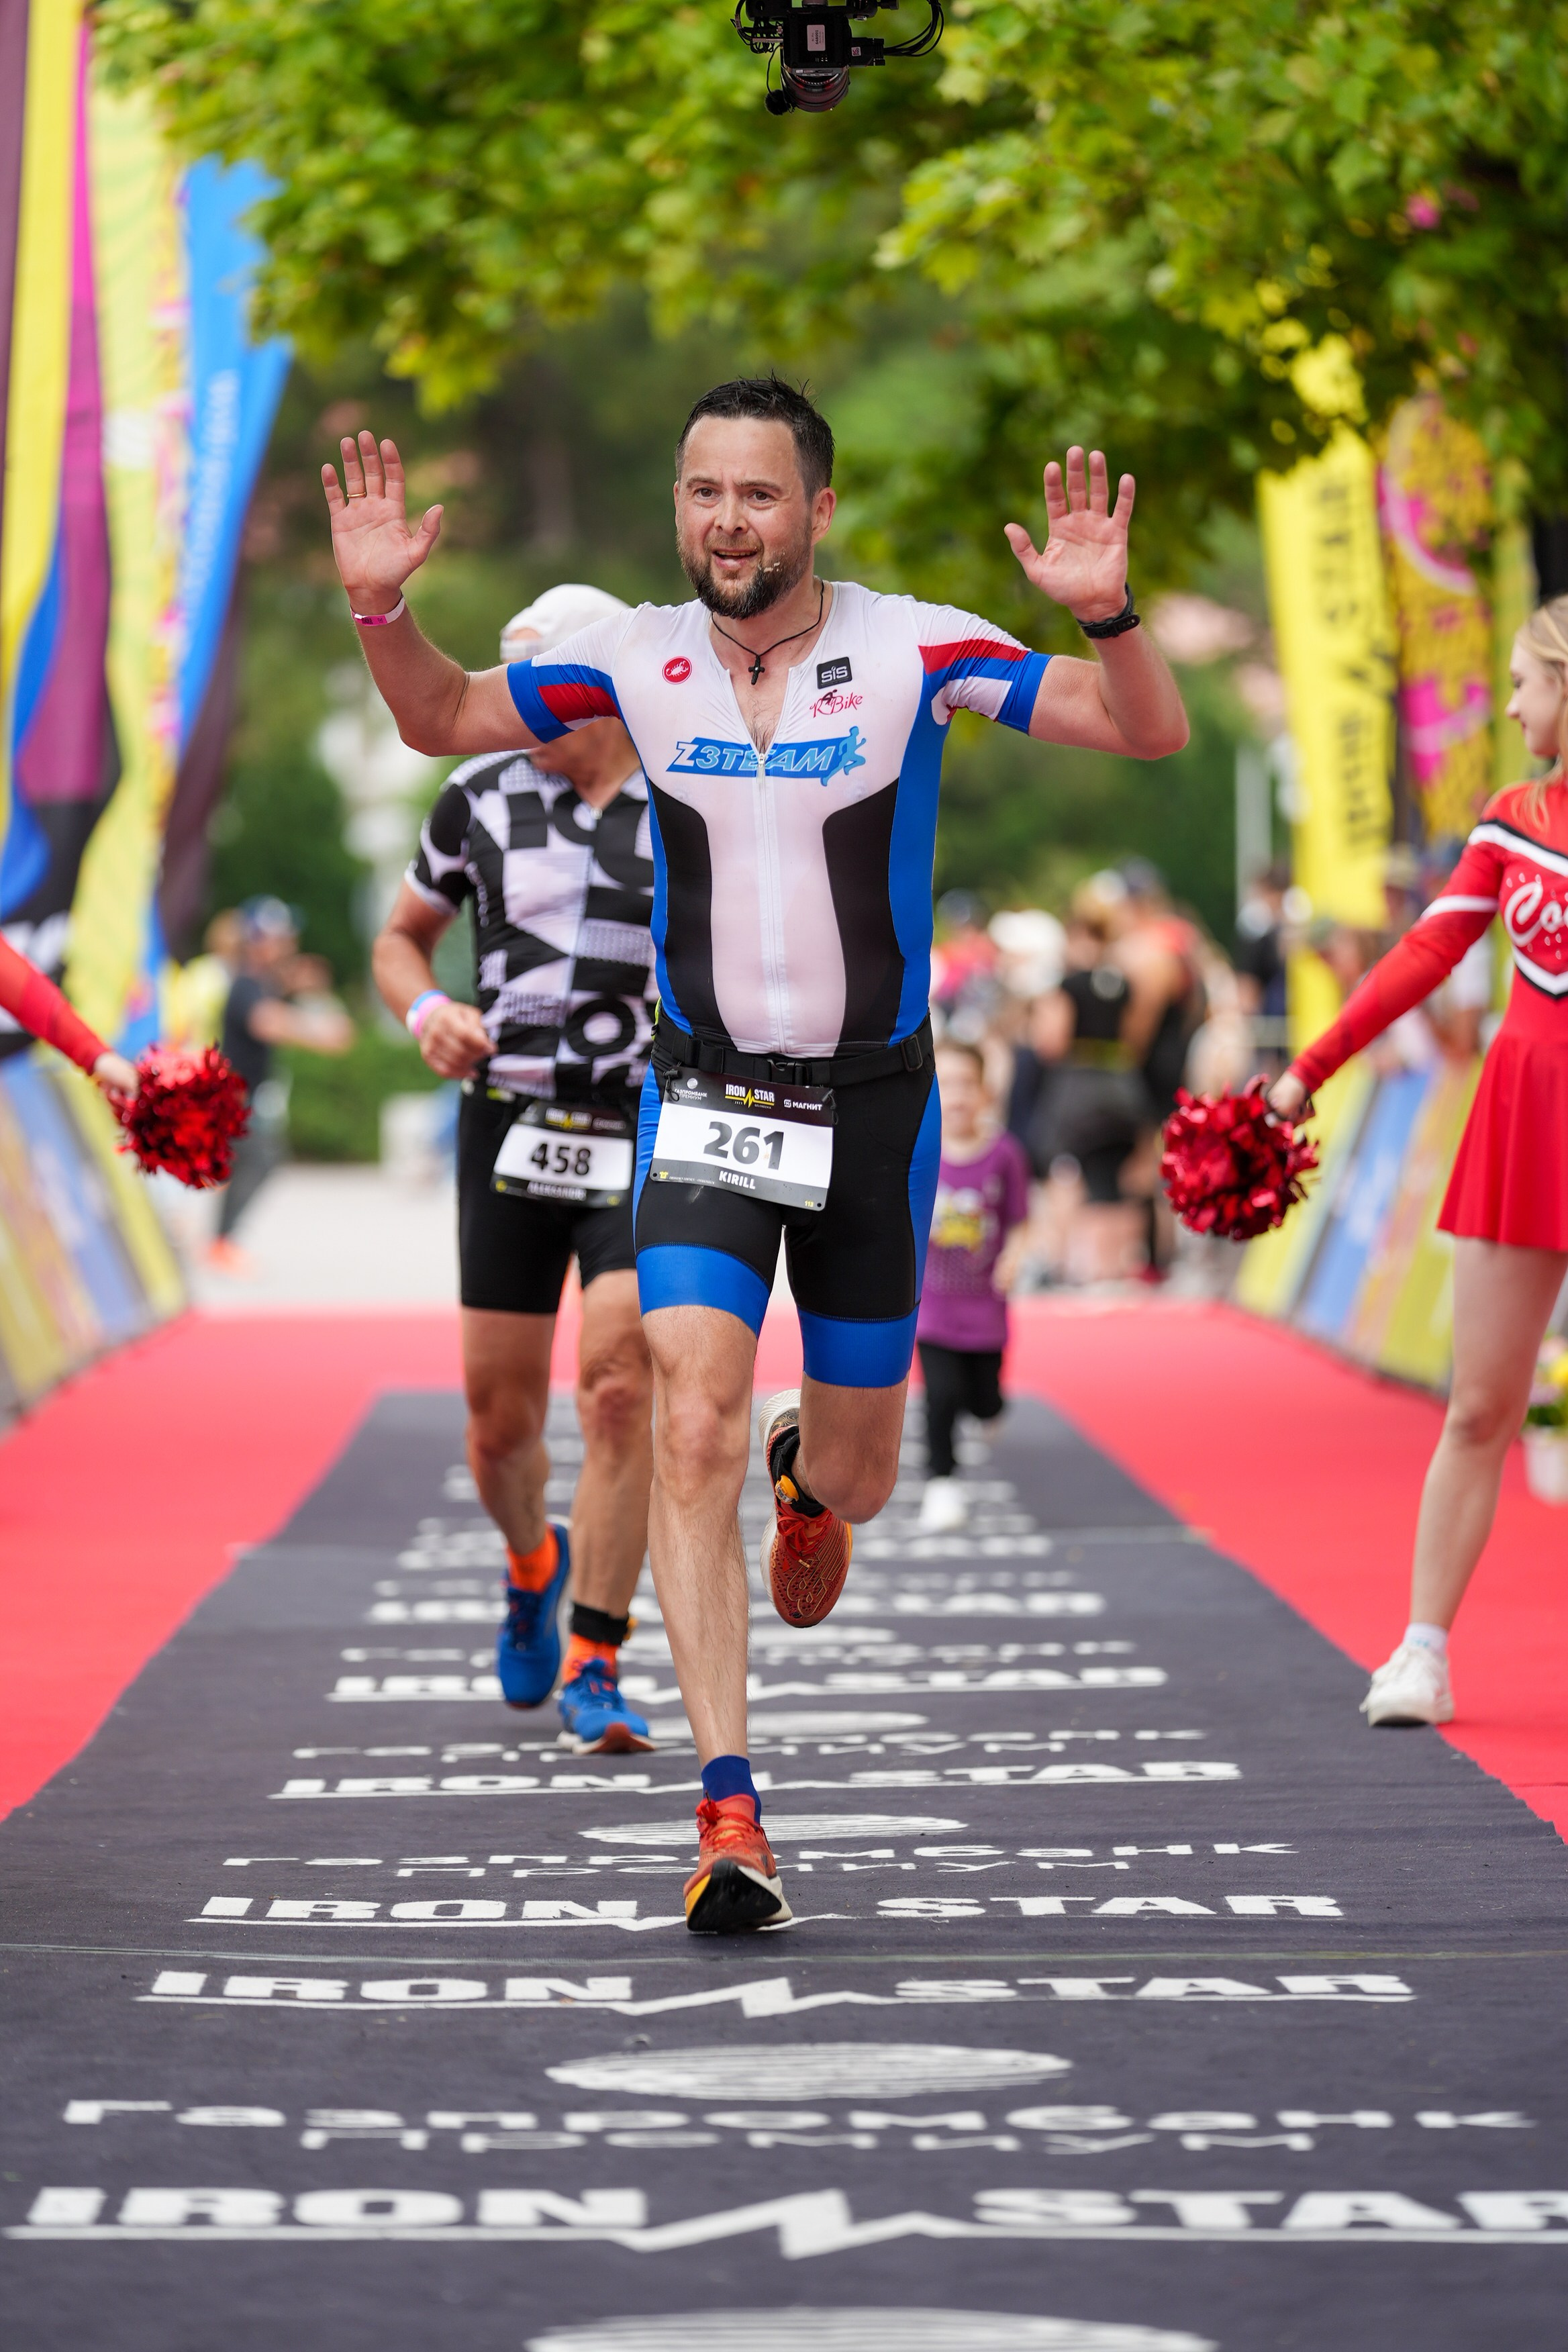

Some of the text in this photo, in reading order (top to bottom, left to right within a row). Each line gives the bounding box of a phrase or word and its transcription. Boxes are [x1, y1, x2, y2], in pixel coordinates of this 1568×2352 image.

[673, 742, 836, 772] Z3TEAM
[726, 1083, 775, 1103] IRON STAR
[793, 1101, 823, 1111] МАГНИТ
[531, 1143, 591, 1176] 458
[703, 1121, 785, 1171] 261
[718, 1170, 756, 1191] KIRILL
[282, 1761, 1240, 1794] IRON STAR
[223, 1843, 1300, 1867] газпрмбанк
[200, 1895, 1344, 1919] IRON STAR
[151, 1971, 1412, 2002] IRON STAR
[26, 2186, 648, 2228] IRON
